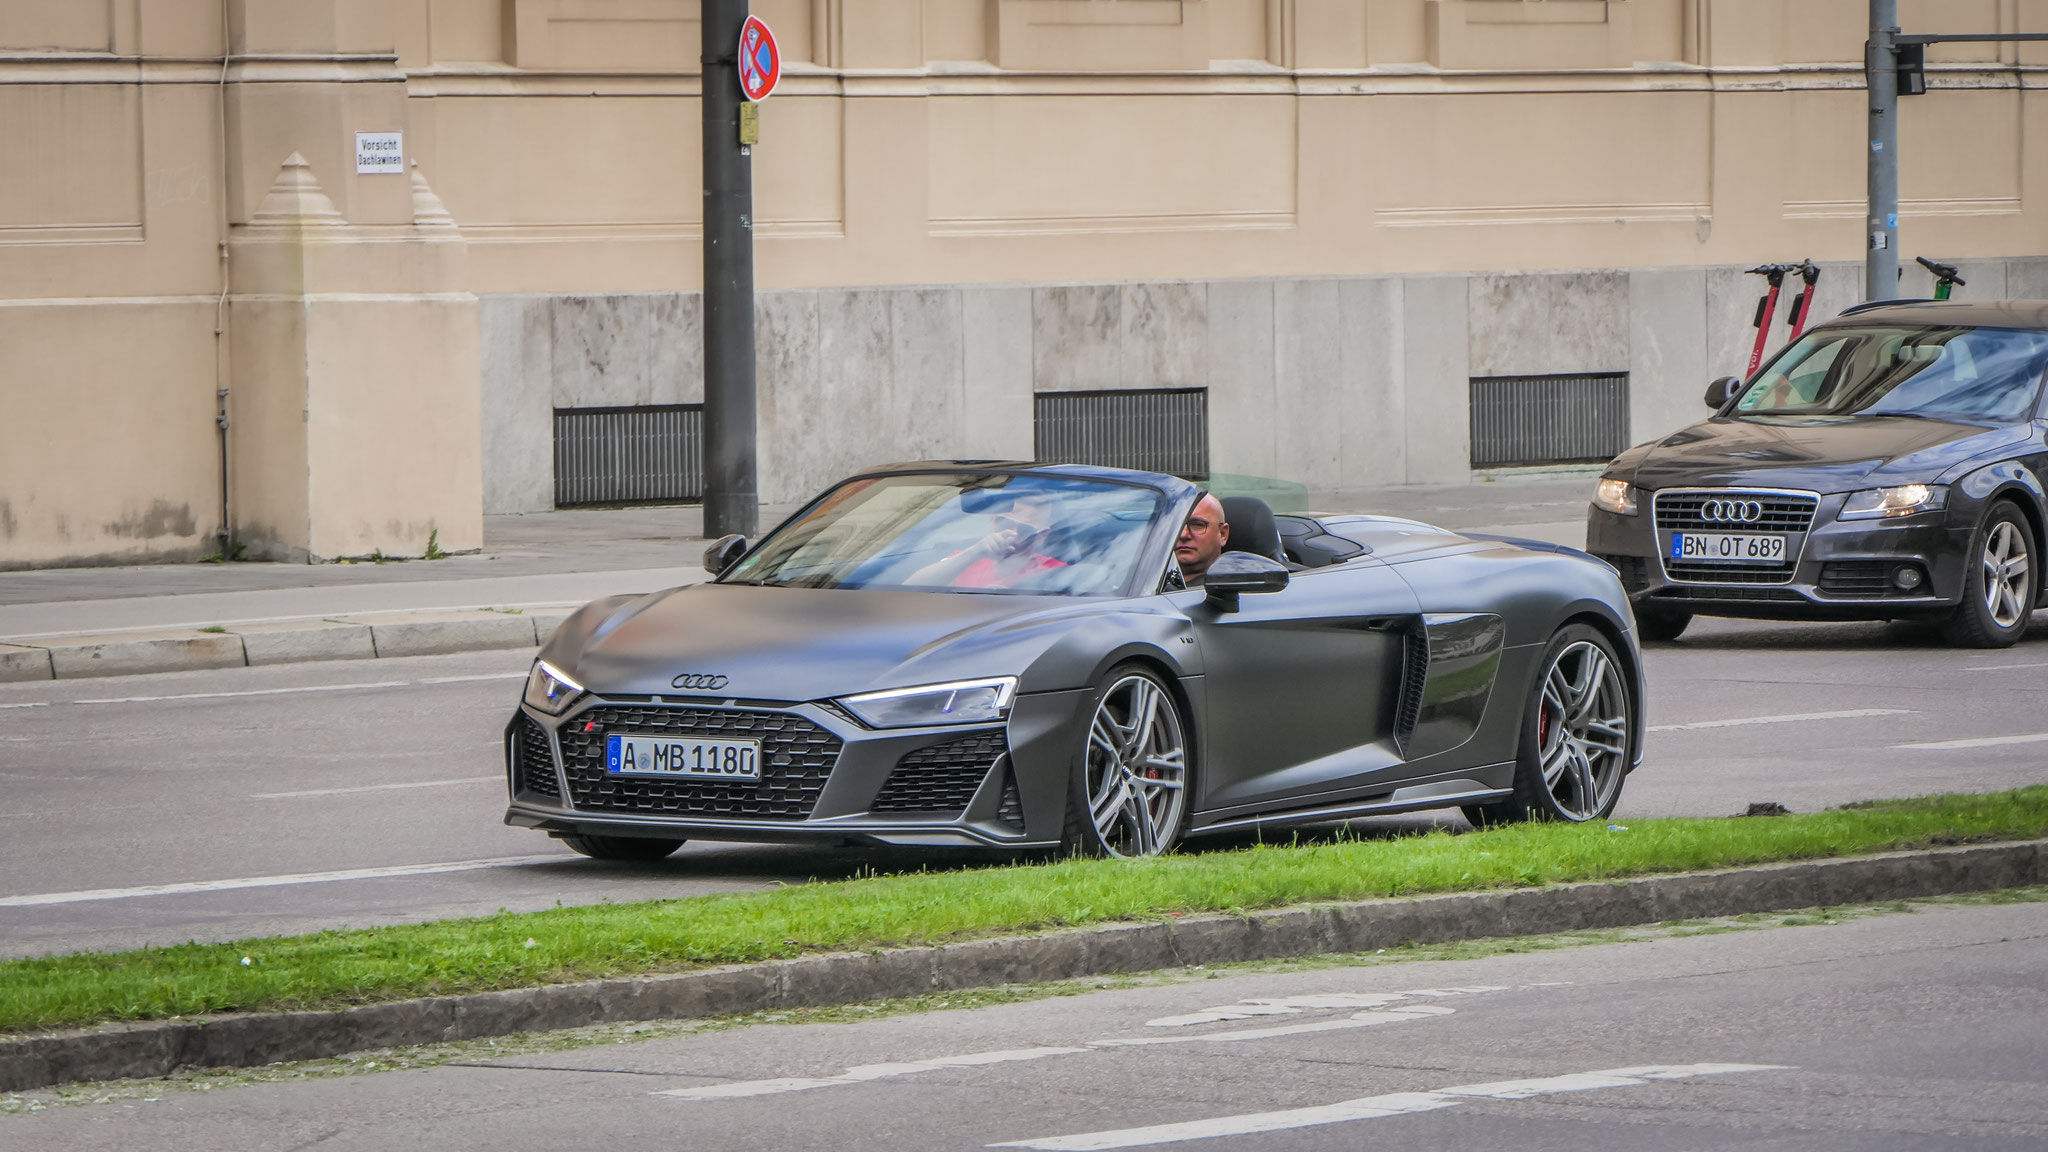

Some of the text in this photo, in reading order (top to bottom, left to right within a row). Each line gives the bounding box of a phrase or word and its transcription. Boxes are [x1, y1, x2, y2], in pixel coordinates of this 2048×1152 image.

[361, 139, 397, 151] Vorsicht
[358, 153, 401, 166] Dachlawinen
[1683, 536, 1707, 556] BN
[1720, 537, 1744, 557] OT
[1747, 538, 1783, 558] 689
[611, 742, 755, 775] D A MB 1180
